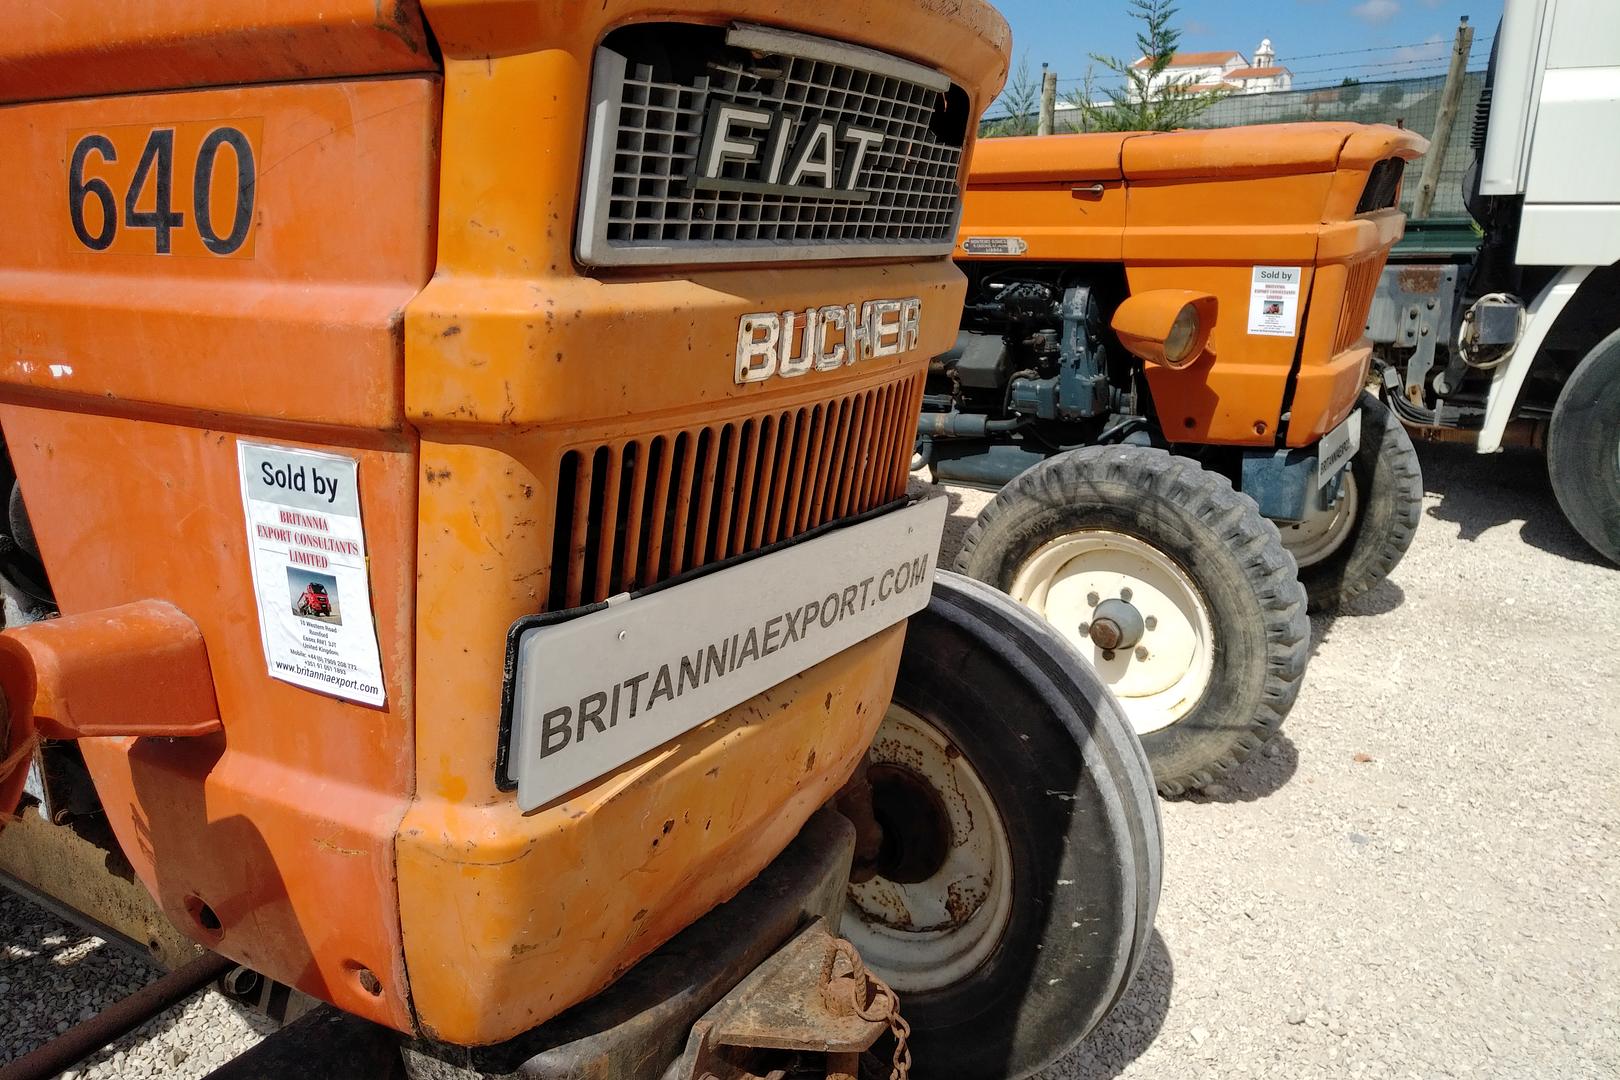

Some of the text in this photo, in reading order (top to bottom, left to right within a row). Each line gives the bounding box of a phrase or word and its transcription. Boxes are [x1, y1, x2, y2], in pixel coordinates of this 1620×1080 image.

[706, 107, 884, 190] FIAT
[69, 126, 256, 256] 640
[1261, 271, 1292, 280] Sold by
[735, 297, 921, 384] BUCHER
[261, 461, 338, 503] Sold by
[279, 510, 329, 531] BRITANNIA
[257, 524, 359, 555] EXPORT CONSULTANTS
[289, 550, 328, 568] LIMITED
[303, 642, 339, 656] United Kingdom
[539, 553, 929, 760] BRITANNIAEXPORT.COM
[275, 661, 379, 695] www.britanniaexport.com
